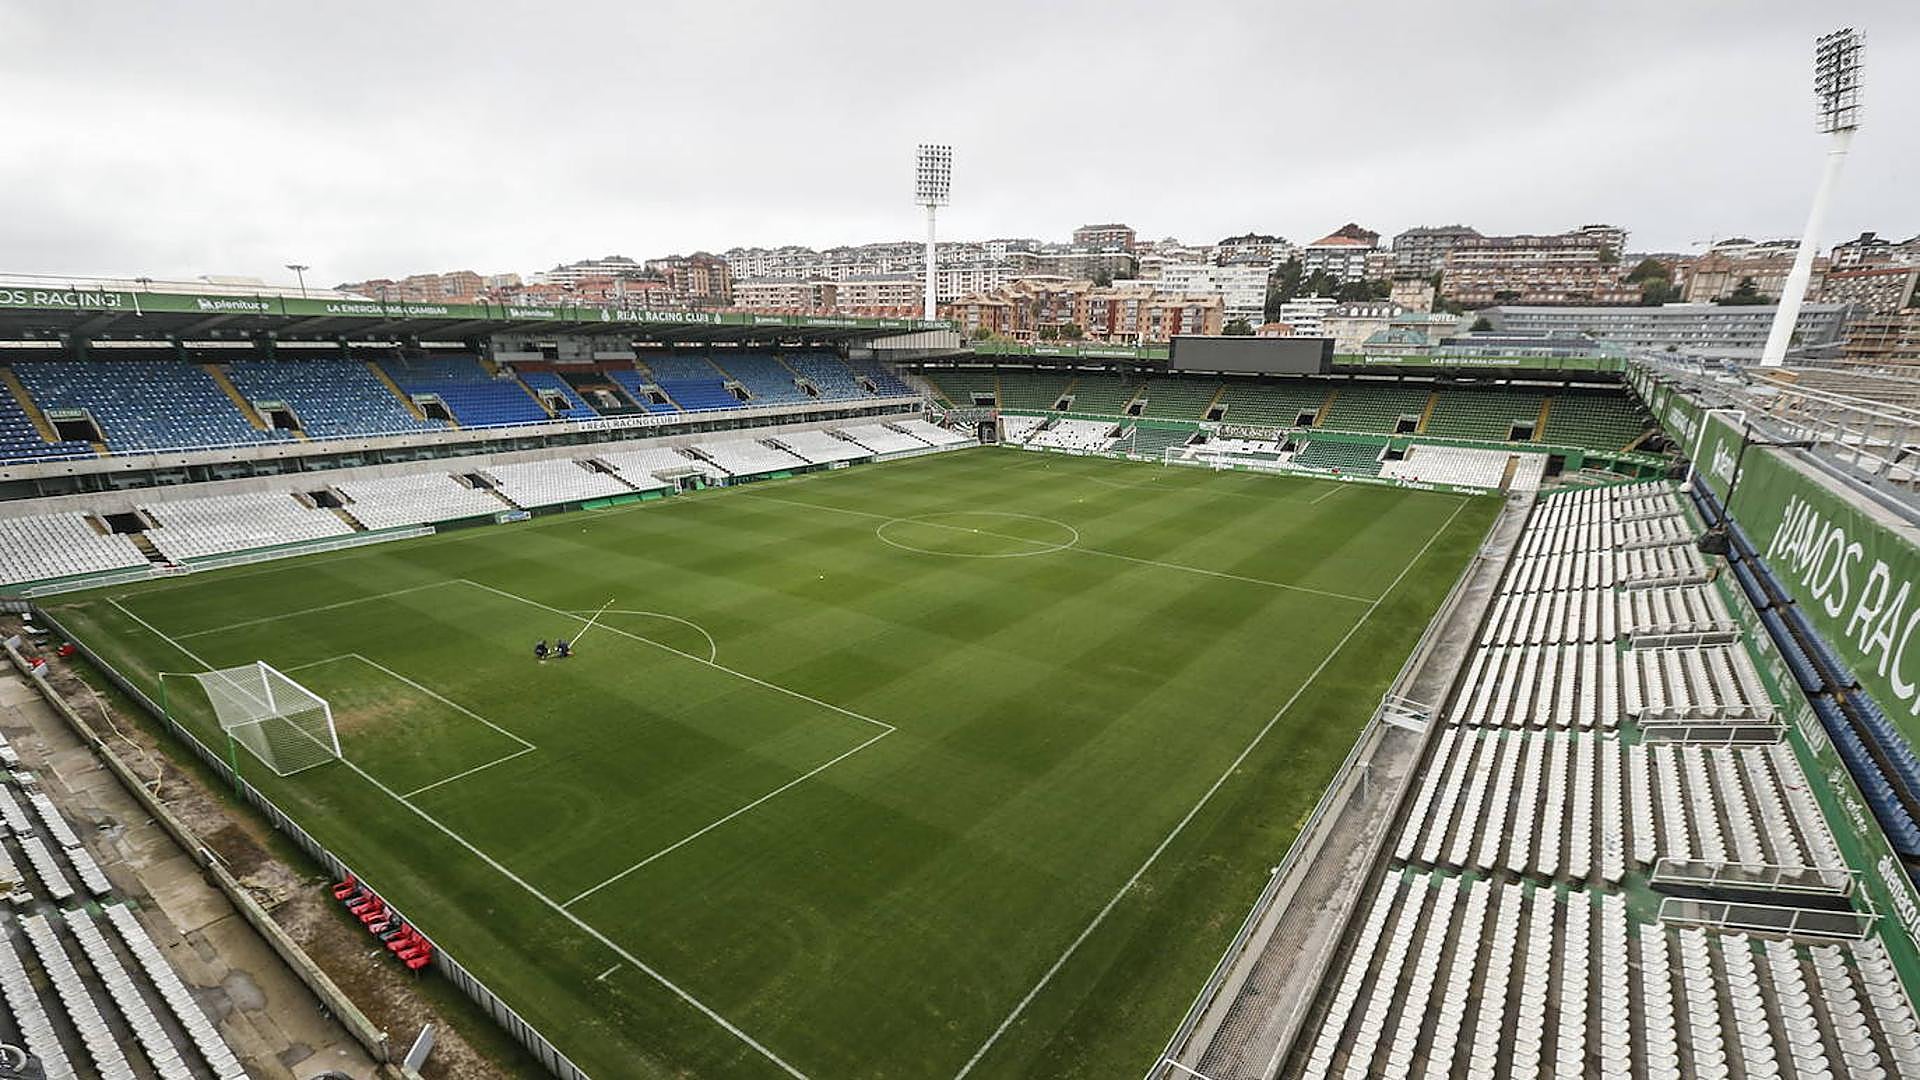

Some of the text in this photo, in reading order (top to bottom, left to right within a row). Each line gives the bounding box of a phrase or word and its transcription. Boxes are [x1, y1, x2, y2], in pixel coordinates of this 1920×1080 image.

[33, 292, 121, 307] RACING!
[617, 310, 708, 321] REAL RACING CLUB
[1429, 313, 1457, 322] HOTEL
[587, 421, 611, 430] REAL
[613, 417, 649, 428] RACING
[1845, 558, 1920, 716] RAC
